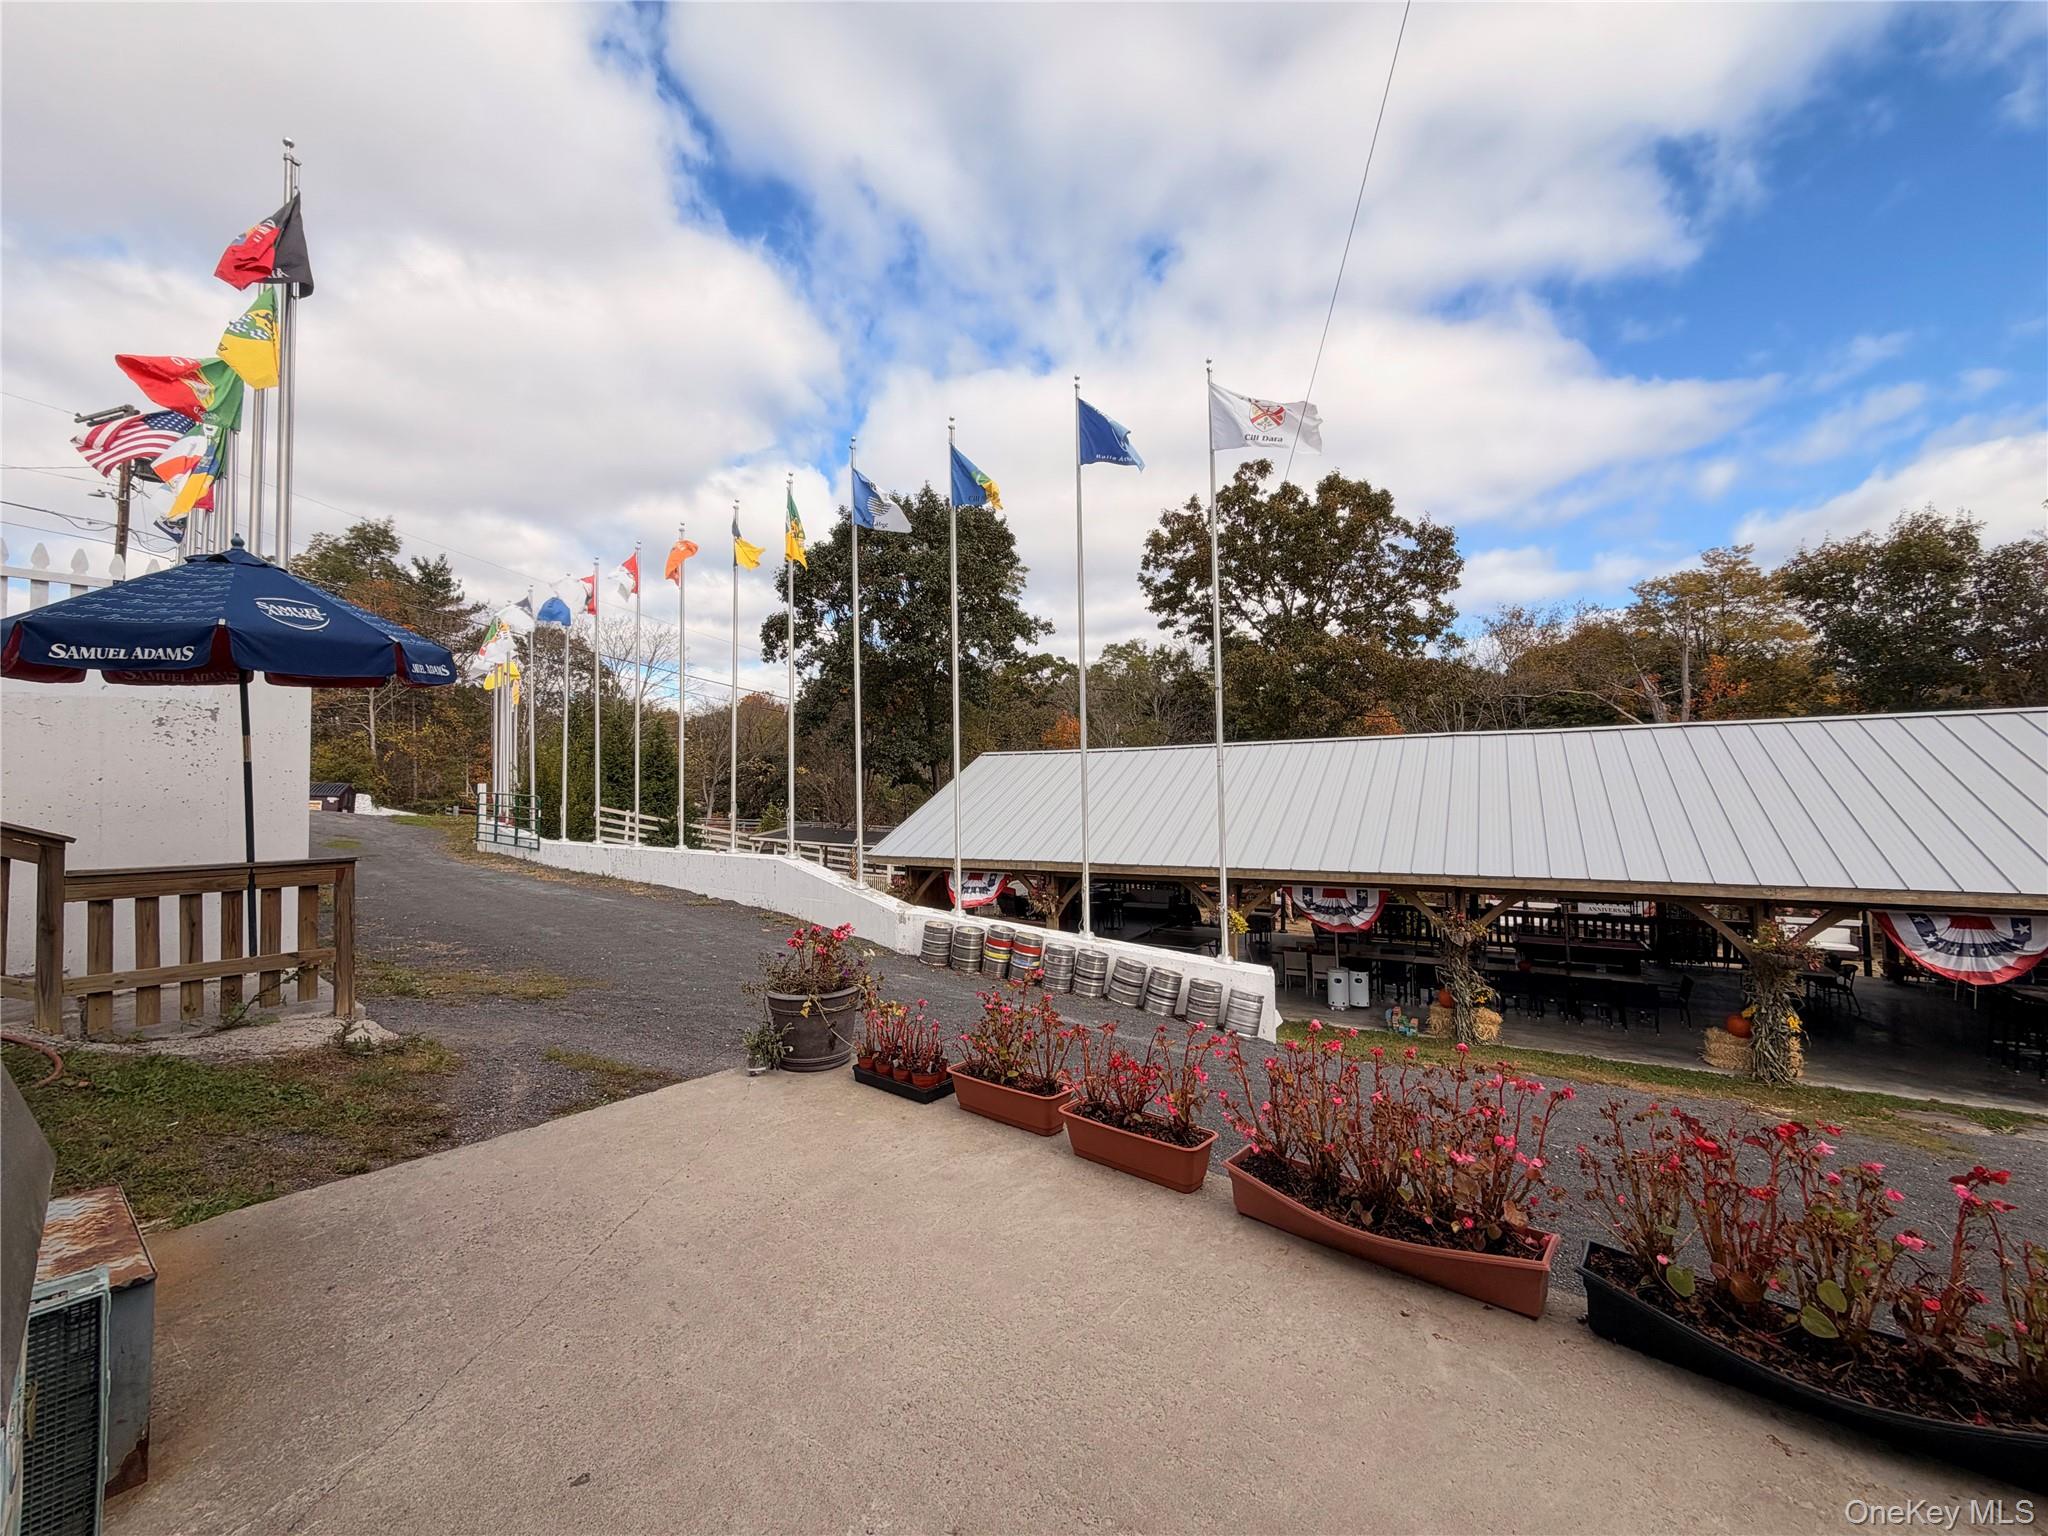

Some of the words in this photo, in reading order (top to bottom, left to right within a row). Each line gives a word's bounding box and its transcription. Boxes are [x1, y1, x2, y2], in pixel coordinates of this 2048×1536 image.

[256, 601, 327, 617] SAMUEL
[267, 608, 325, 621] ADAMS
[49, 643, 129, 660] SAMUEL
[131, 645, 195, 661] ADAMS
